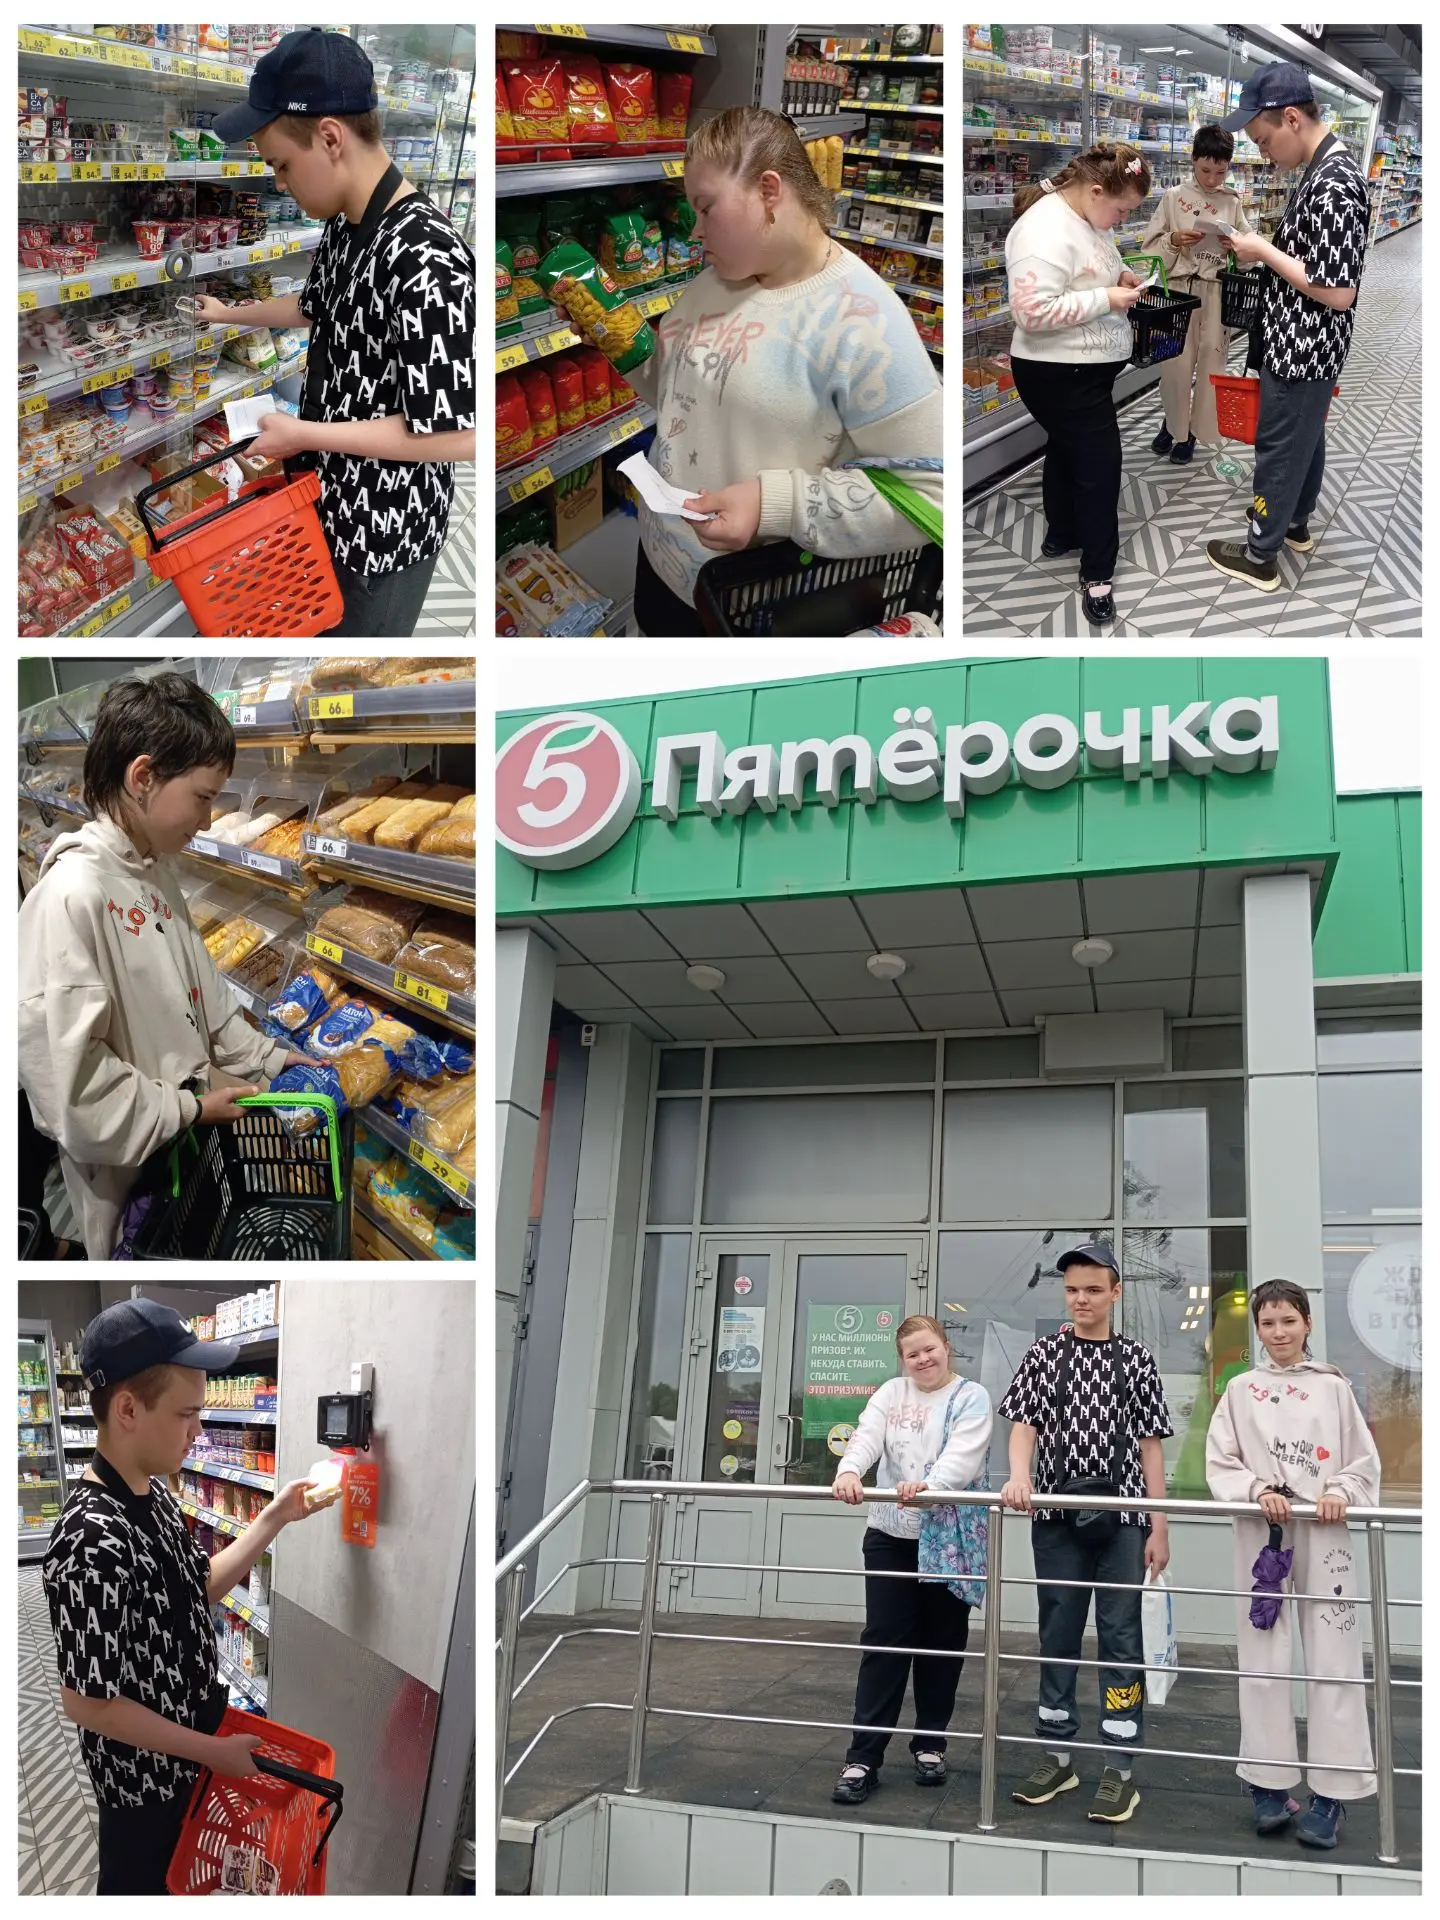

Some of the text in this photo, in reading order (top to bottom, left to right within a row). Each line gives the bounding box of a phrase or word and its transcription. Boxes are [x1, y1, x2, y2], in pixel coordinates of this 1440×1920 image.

[560, 24, 574, 36] 59
[287, 101, 308, 112] NIKE
[559, 337, 571, 347] 59
[501, 355, 516, 368] 59
[531, 478, 545, 489] 56
[329, 702, 342, 715] 66
[243, 713, 251, 722] 69
[651, 694, 1281, 824] Пятёрочка
[321, 841, 334, 853] 66
[322, 946, 333, 957] 66
[416, 982, 429, 999] 81
[431, 1159, 449, 1178] 29
[812, 1333, 891, 1342] У НАС МИЛЛИОНЫ
[853, 1346, 866, 1355] ИХ
[810, 1359, 845, 1369] НЕКУДА
[809, 1372, 852, 1381] СПАСИТЕ.
[808, 1385, 826, 1394] ЭТО
[350, 1484, 371, 1506] 7%
[1336, 1614, 1356, 1635] YOU
